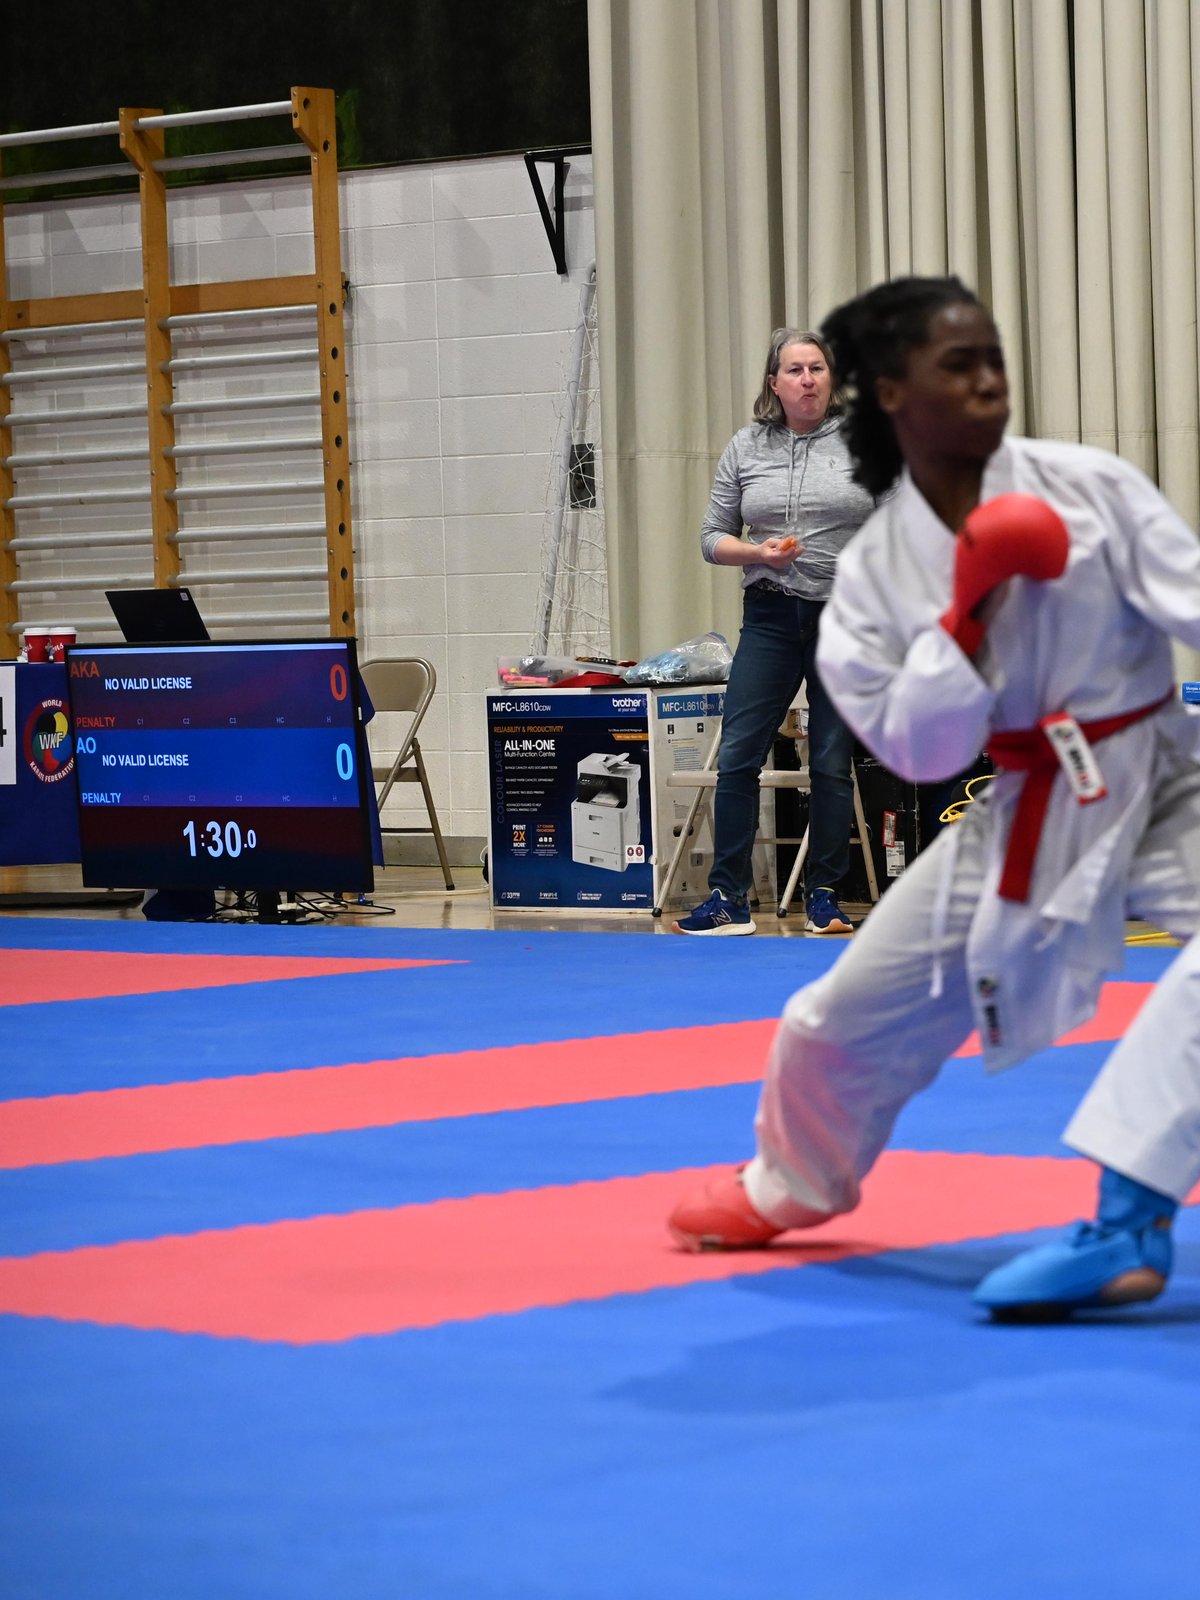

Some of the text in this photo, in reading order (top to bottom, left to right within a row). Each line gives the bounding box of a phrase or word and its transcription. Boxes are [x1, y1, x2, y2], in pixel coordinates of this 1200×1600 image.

[71, 661, 99, 678] AKA
[104, 676, 192, 690] NO VALID LICENSE
[330, 664, 347, 701] 0
[42, 699, 63, 708] WORLD
[612, 698, 642, 708] brother
[76, 716, 115, 727] PENALTY
[527, 725, 564, 733] PRODUCTIVITY
[39, 732, 63, 750] WKF
[76, 736, 97, 754] AO
[504, 739, 555, 750] ALL-IN-ONE
[102, 753, 189, 767] NO VALID LICENSE
[335, 743, 353, 781] 0
[82, 792, 121, 804] PENALTY
[513, 831, 526, 842] 2X
